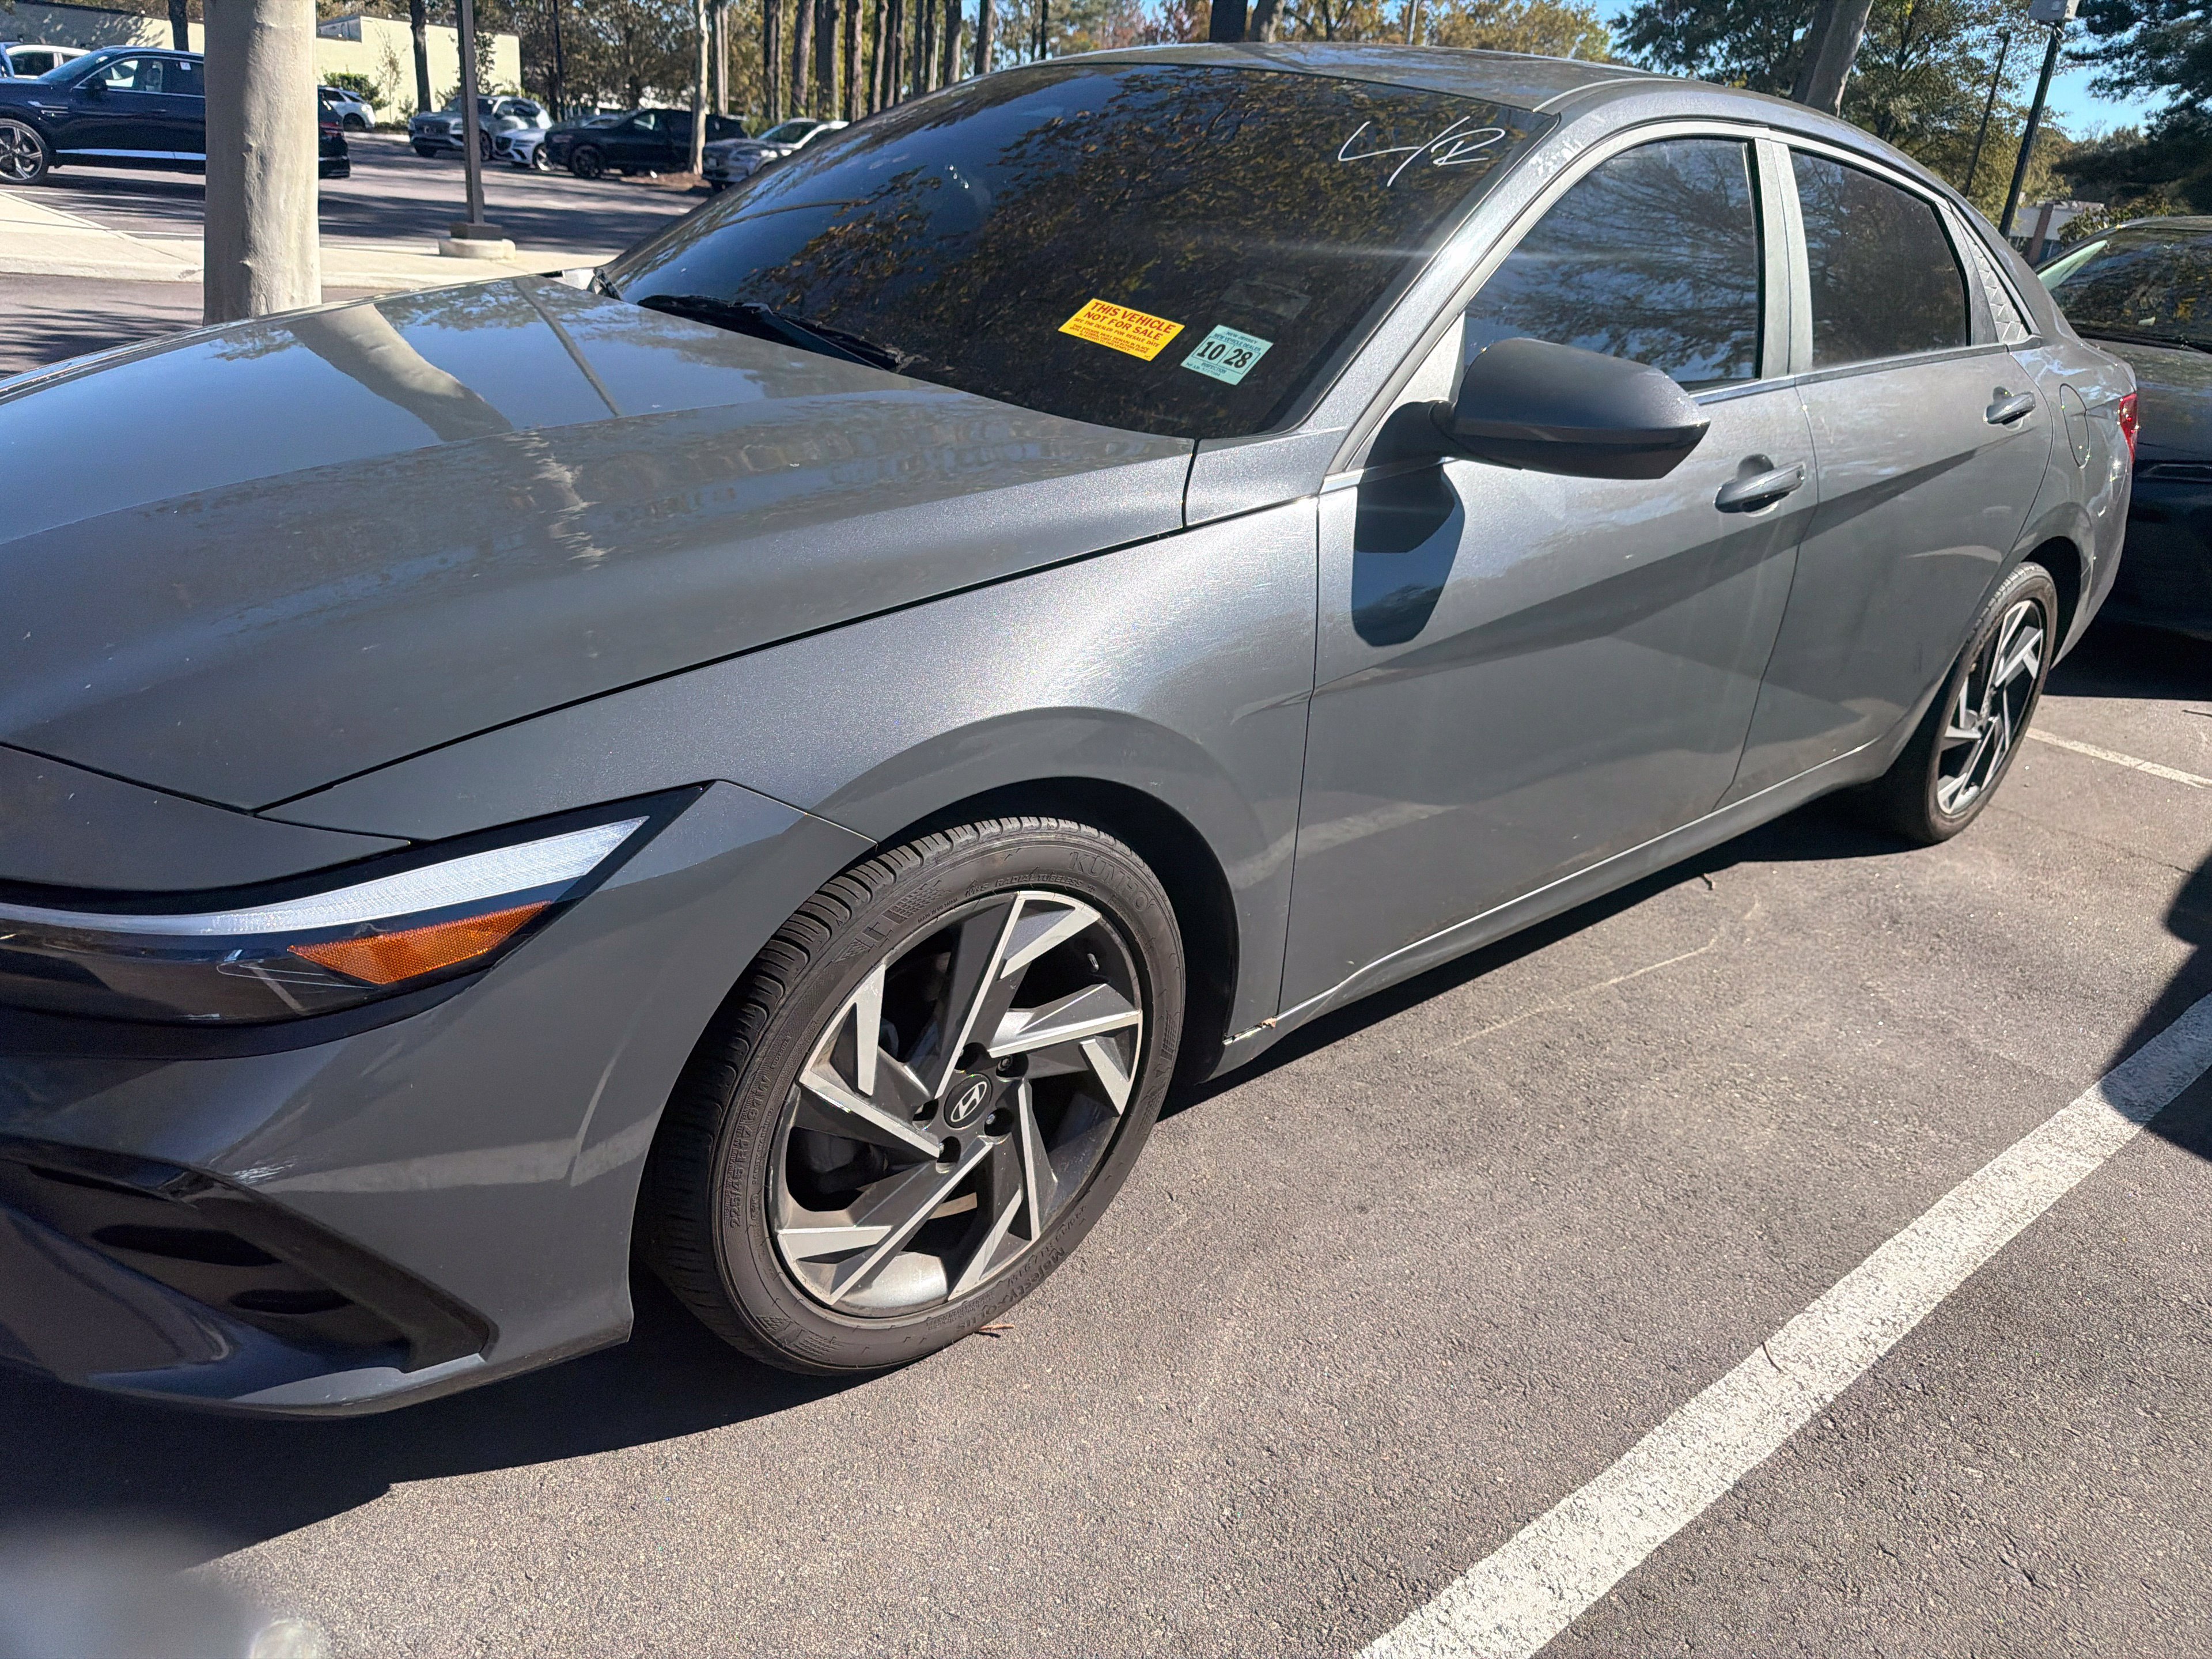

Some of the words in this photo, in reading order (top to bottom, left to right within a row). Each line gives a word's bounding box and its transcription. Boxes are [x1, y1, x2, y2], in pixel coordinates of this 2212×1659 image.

[1084, 312, 1109, 324] NOT
[1108, 319, 1132, 331] FOR
[1132, 326, 1164, 340] SALE
[1090, 302, 1121, 317] THIS
[1121, 310, 1176, 334] VEHICLE
[1094, 323, 1113, 332] DEALER
[1126, 333, 1145, 343] RESALE
[1146, 340, 1160, 348] DATE
[1224, 336, 1243, 346] VEHICLE
[1243, 342, 1262, 352] DEALER
[1238, 335, 1258, 344] JERSEY
[1196, 341, 1226, 360] 10
[1223, 349, 1253, 369] 28
[995, 873, 1034, 887] RADIAL
[1037, 873, 1084, 888] TUBELESS
